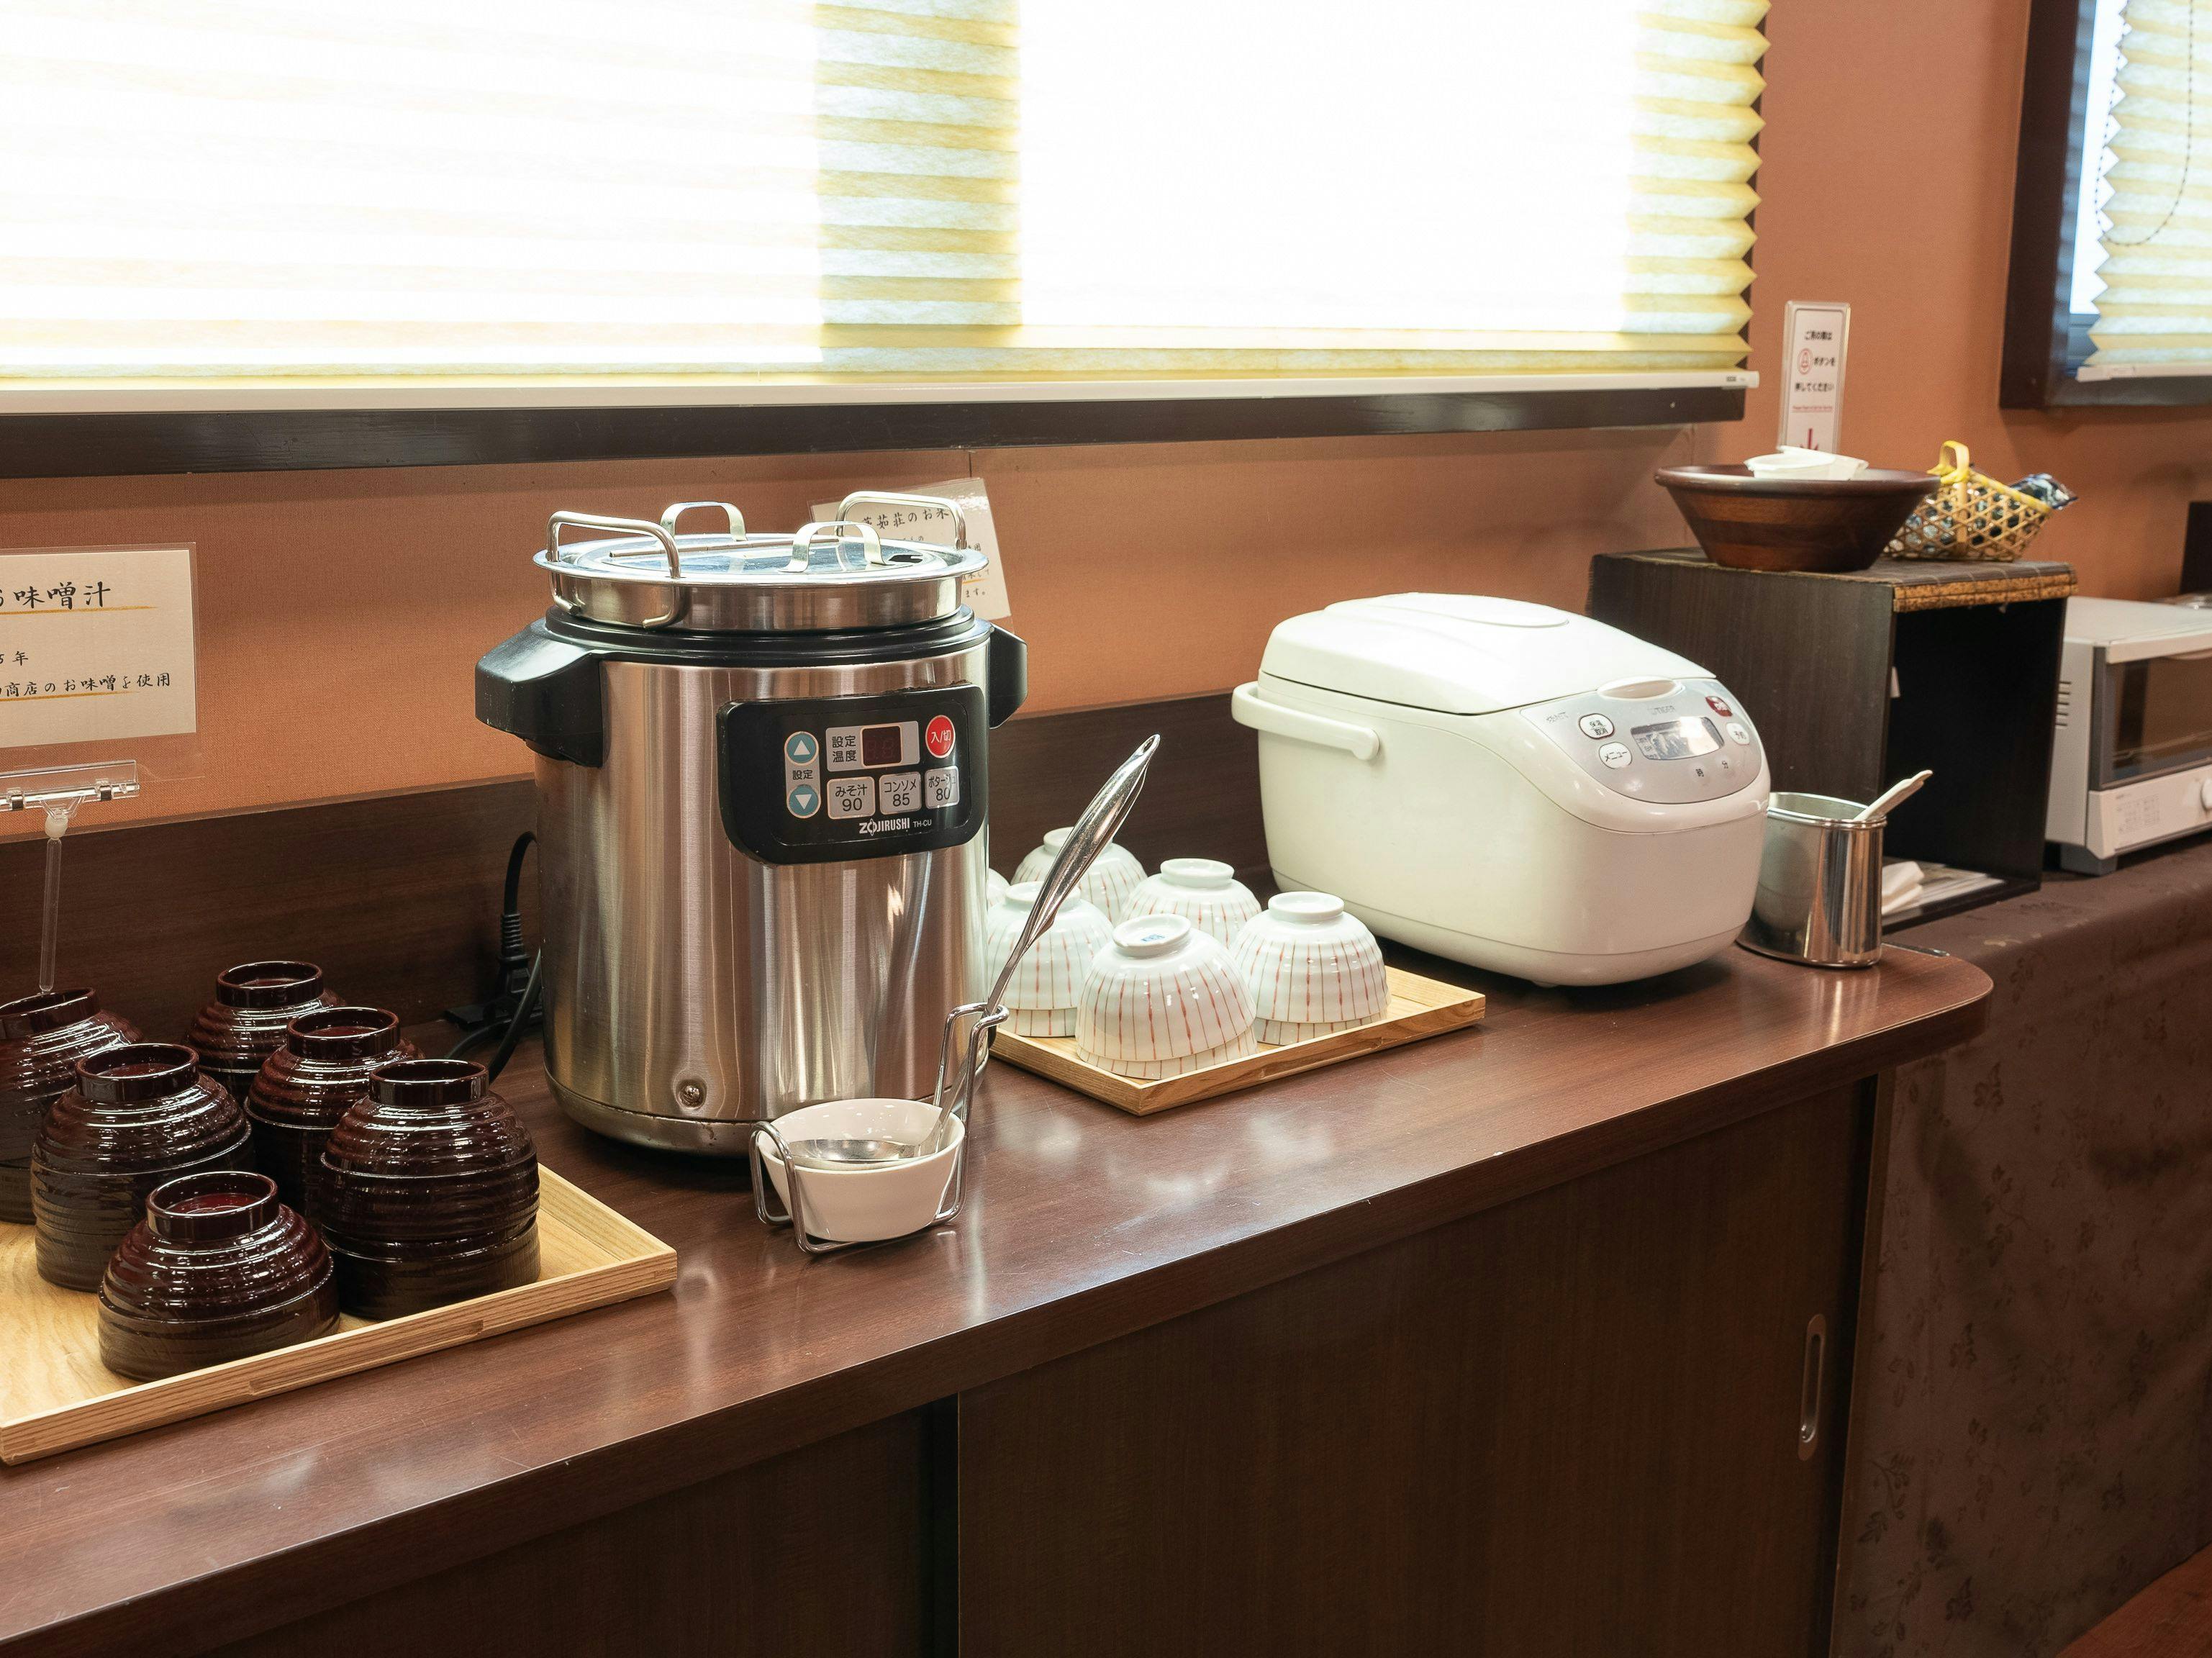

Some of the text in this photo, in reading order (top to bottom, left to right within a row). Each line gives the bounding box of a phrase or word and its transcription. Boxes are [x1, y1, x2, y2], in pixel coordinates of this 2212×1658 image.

[0, 581, 111, 610] 味噌汁
[0, 672, 171, 697] 商店のお味噌を使用
[832, 735, 856, 748] 設定
[930, 730, 951, 743] 入/切
[833, 751, 857, 763] 温度
[792, 769, 813, 780] 設定
[835, 784, 868, 798] みそ汁
[884, 779, 917, 793] コンソメ
[892, 793, 910, 807] 85
[936, 787, 951, 801] 80
[842, 797, 863, 812] 90
[859, 817, 910, 835] ZOJIRUSHI
